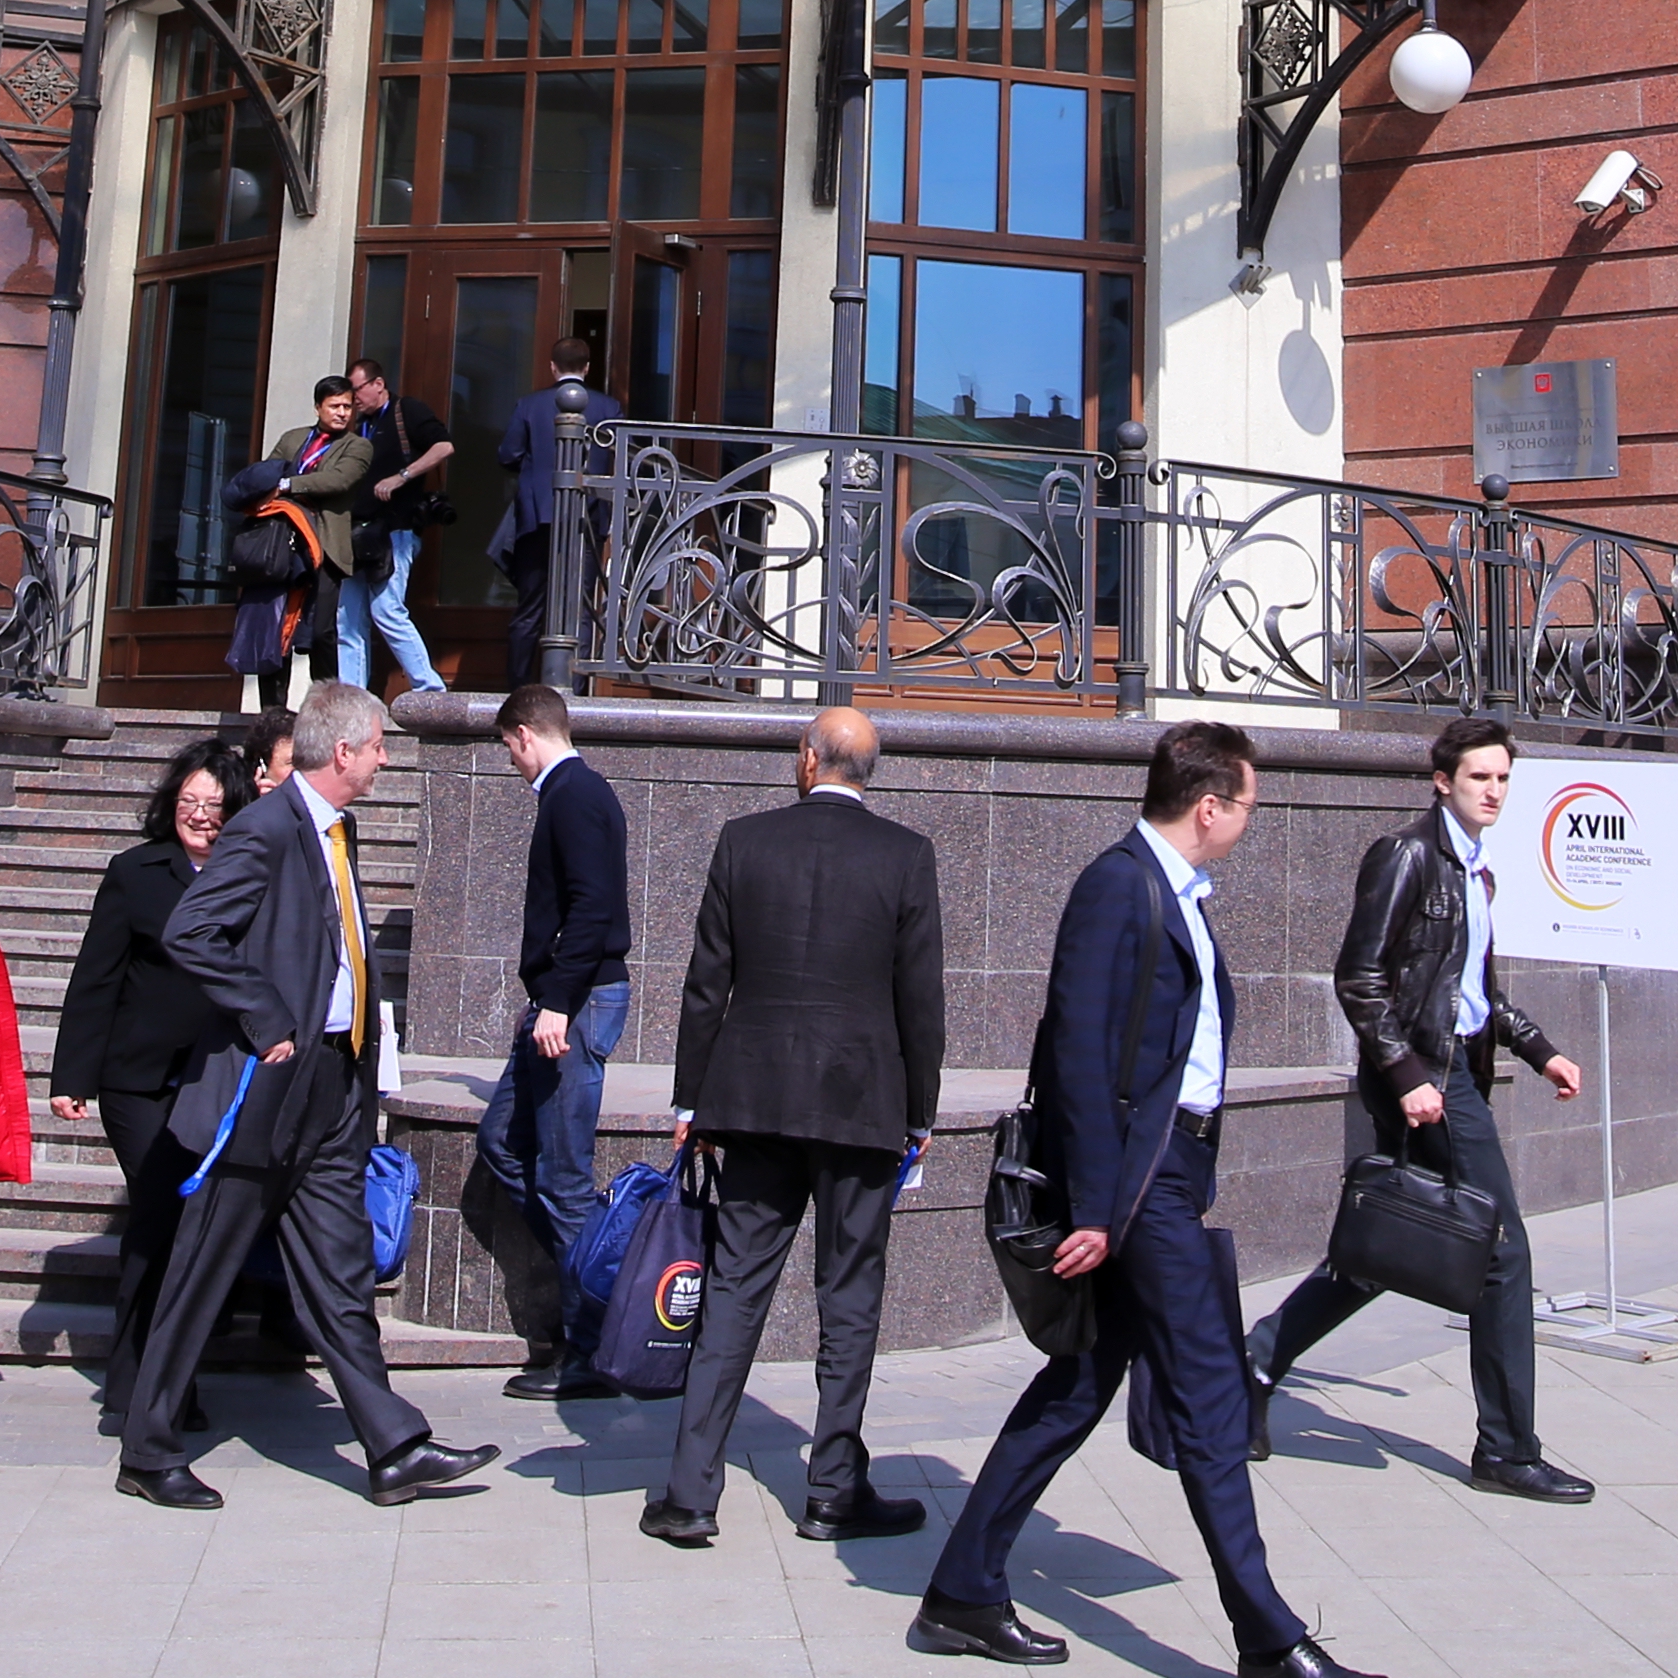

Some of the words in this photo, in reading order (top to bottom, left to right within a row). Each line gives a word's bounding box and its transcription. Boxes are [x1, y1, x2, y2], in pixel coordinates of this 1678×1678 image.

[1485, 420, 1547, 435] ВЫСШАЯ
[1496, 435, 1593, 452] ЭКОНОМИКИ
[1566, 813, 1625, 841] XVIII
[1565, 844, 1587, 853] APRIL
[1588, 845, 1645, 856] INTERNATIONAL
[1565, 854, 1602, 863] ACADEMIC
[1603, 856, 1652, 867] CONFERENCE
